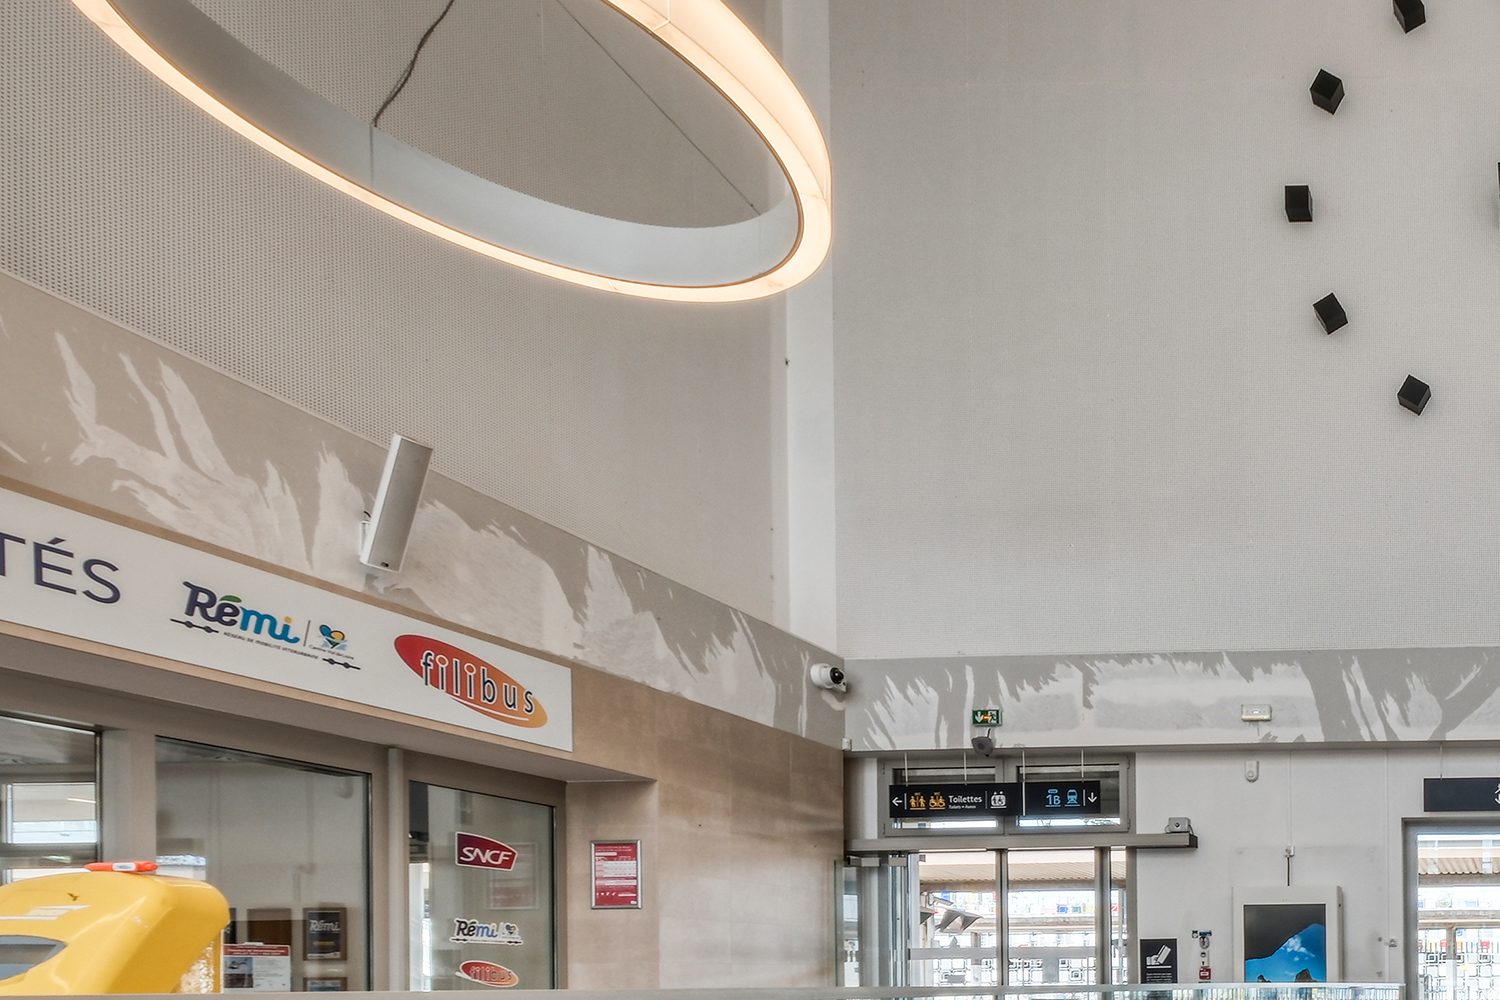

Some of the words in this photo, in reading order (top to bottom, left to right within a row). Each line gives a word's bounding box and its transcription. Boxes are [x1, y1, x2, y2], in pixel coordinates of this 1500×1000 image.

[183, 581, 300, 644] Rémi
[420, 650, 534, 714] filibus
[948, 795, 983, 803] Toilettes
[1045, 793, 1061, 805] 1B
[459, 847, 512, 865] SNCF
[456, 919, 498, 938] Rémi
